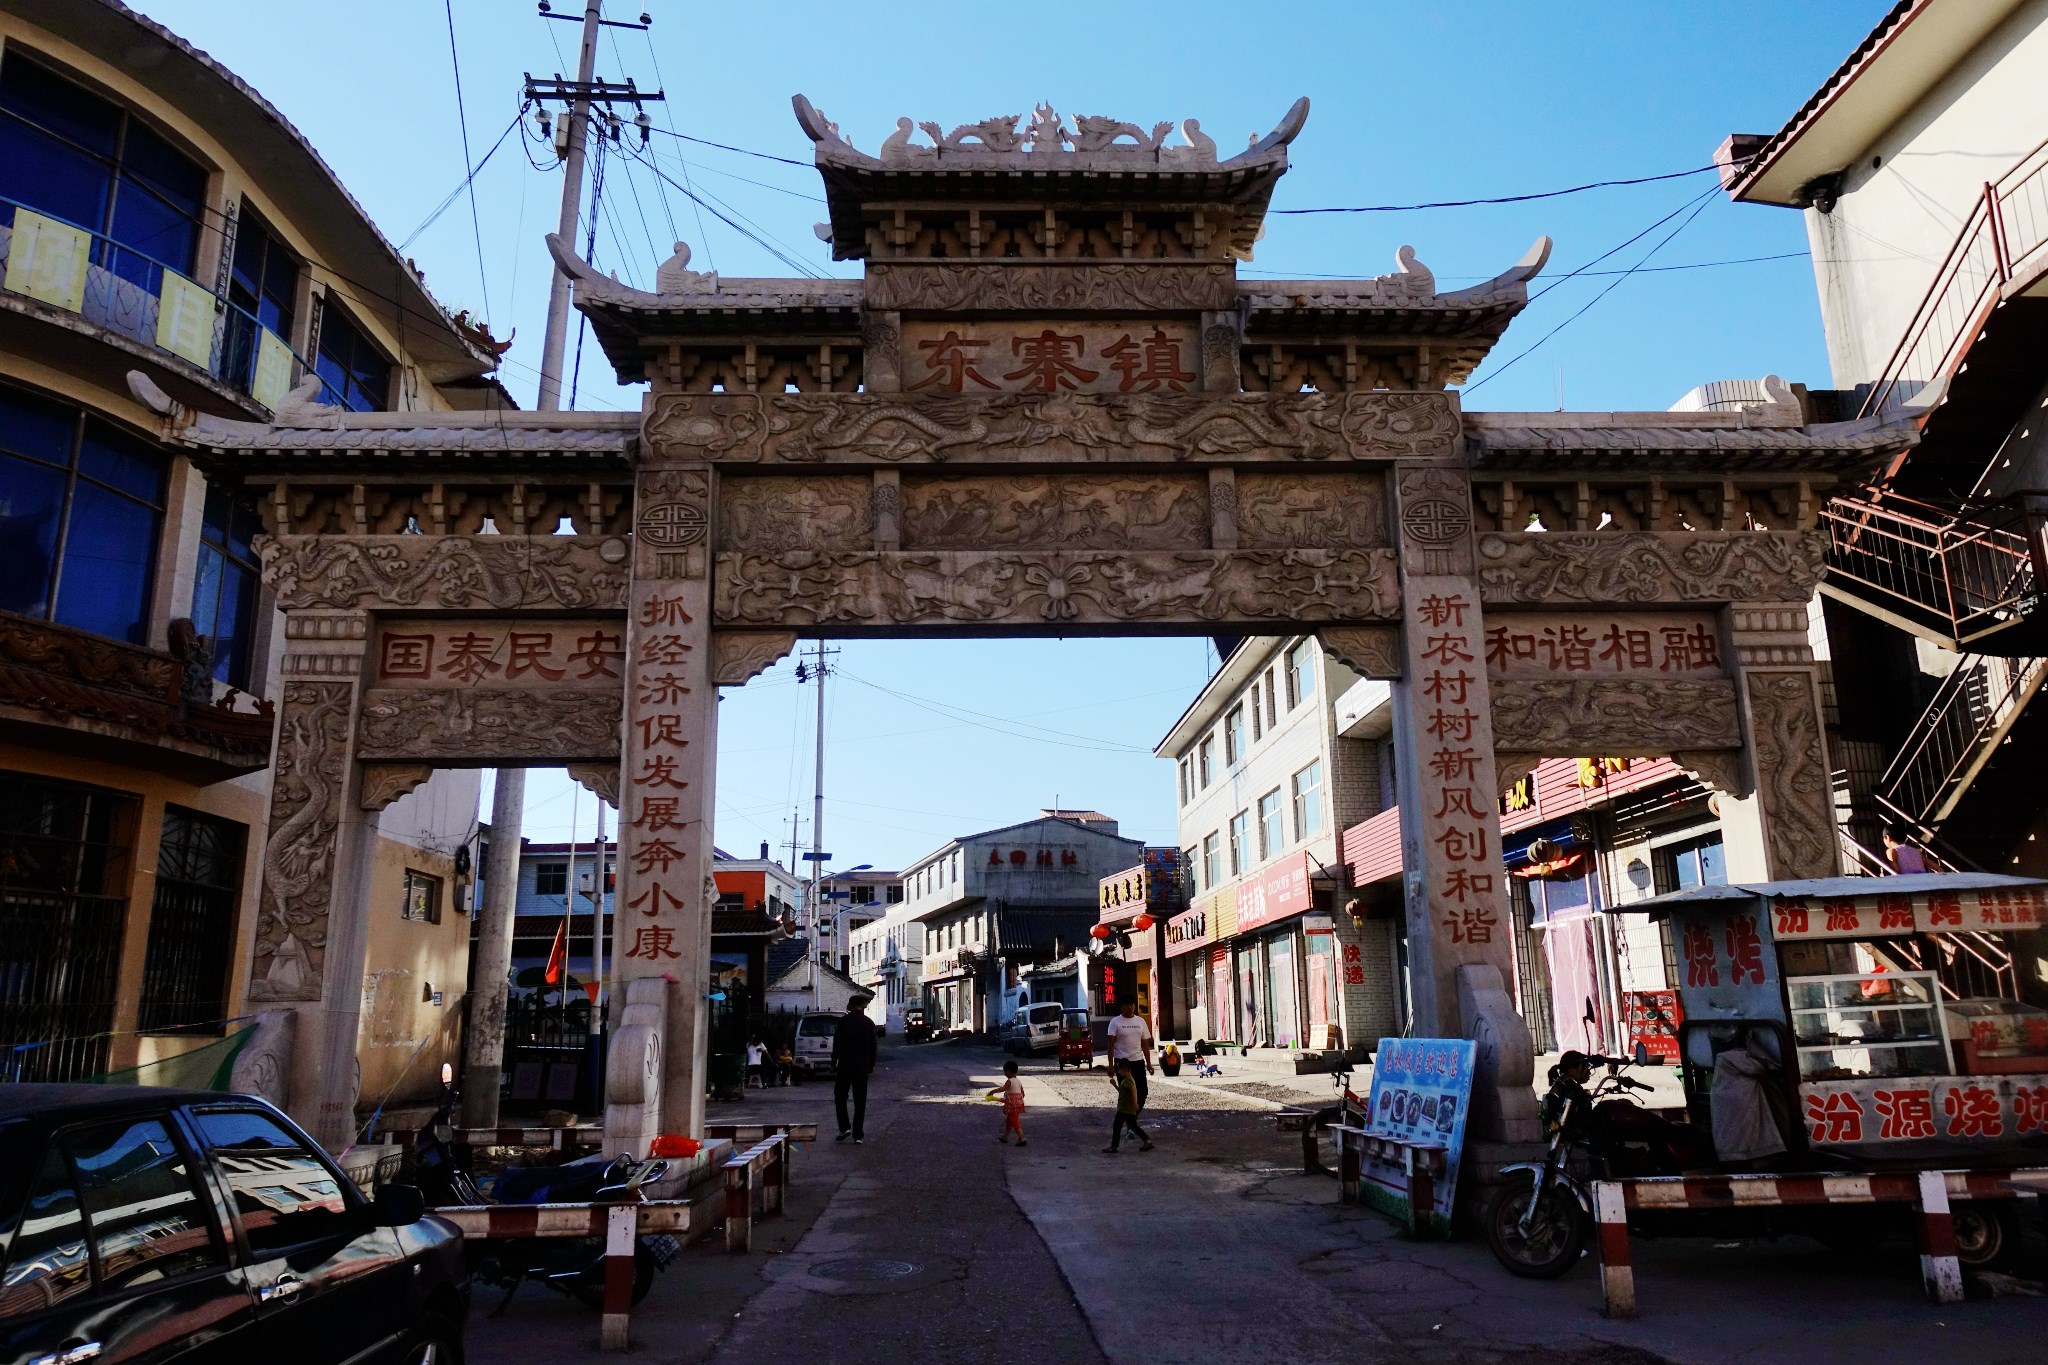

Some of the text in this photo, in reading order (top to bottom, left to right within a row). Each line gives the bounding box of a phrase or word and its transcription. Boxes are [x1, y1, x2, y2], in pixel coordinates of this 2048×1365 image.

[907, 329, 1196, 392] 东寨镇
[380, 631, 625, 682] 国泰民安
[1486, 624, 1721, 672] 和谐相融
[626, 595, 693, 960] 抓经济促发展奔小康
[1418, 593, 1497, 945] 新农村树新风创和谐
[1775, 893, 1963, 933] 汾源烧烤
[1344, 944, 1365, 985] 快递
[1683, 915, 1766, 989] 烧烤
